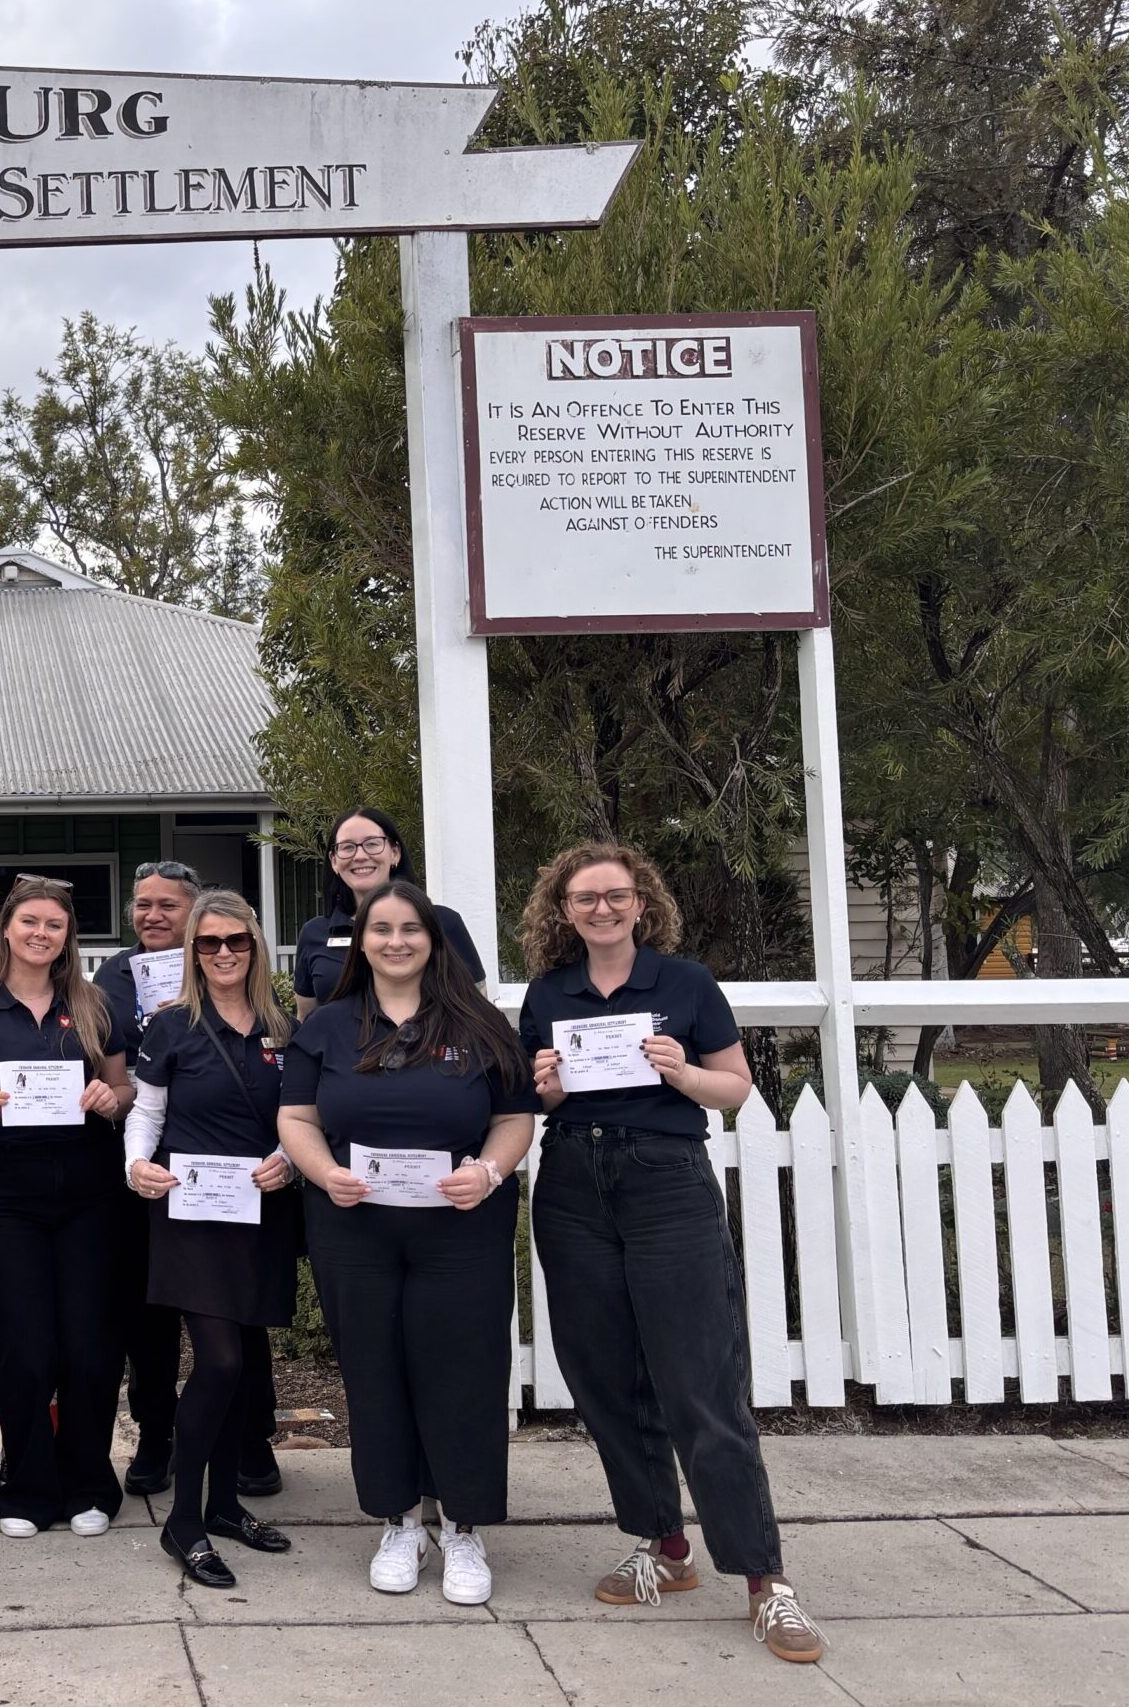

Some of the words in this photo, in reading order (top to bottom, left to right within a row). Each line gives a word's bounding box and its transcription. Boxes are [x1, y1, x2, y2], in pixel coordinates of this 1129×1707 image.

[548, 337, 732, 379] NOTICE
[488, 401, 504, 419] IT
[510, 401, 524, 419] IS
[531, 401, 560, 419] AN
[566, 400, 644, 418] OFFENCE
[650, 399, 673, 416] TO
[680, 398, 735, 416] ENTER
[741, 397, 781, 416] THIS
[518, 424, 586, 441] RESERVE
[597, 422, 683, 440] WITHOUT
[695, 421, 795, 439] AUTHORITY
[489, 450, 526, 465] EVERY
[534, 449, 584, 464] PERSON
[591, 448, 656, 463] ENTERING
[664, 447, 695, 462] THIS
[702, 447, 754, 461] RESERVE
[761, 447, 772, 461] IS
[492, 472, 551, 488] REQUIRED
[557, 472, 575, 487] TO
[581, 471, 627, 486] REPORT
[633, 471, 652, 485] TO
[658, 471, 682, 485] THE
[688, 469, 797, 485] SUPERINTENDENT
[540, 496, 593, 512] ACTION
[595, 495, 628, 510] WILL
[631, 495, 646, 510] BE
[648, 494, 692, 509] TAKEN
[565, 517, 629, 533] AGAINST
[654, 546, 678, 560] THE
[683, 544, 792, 560] SUPERINTENDENT
